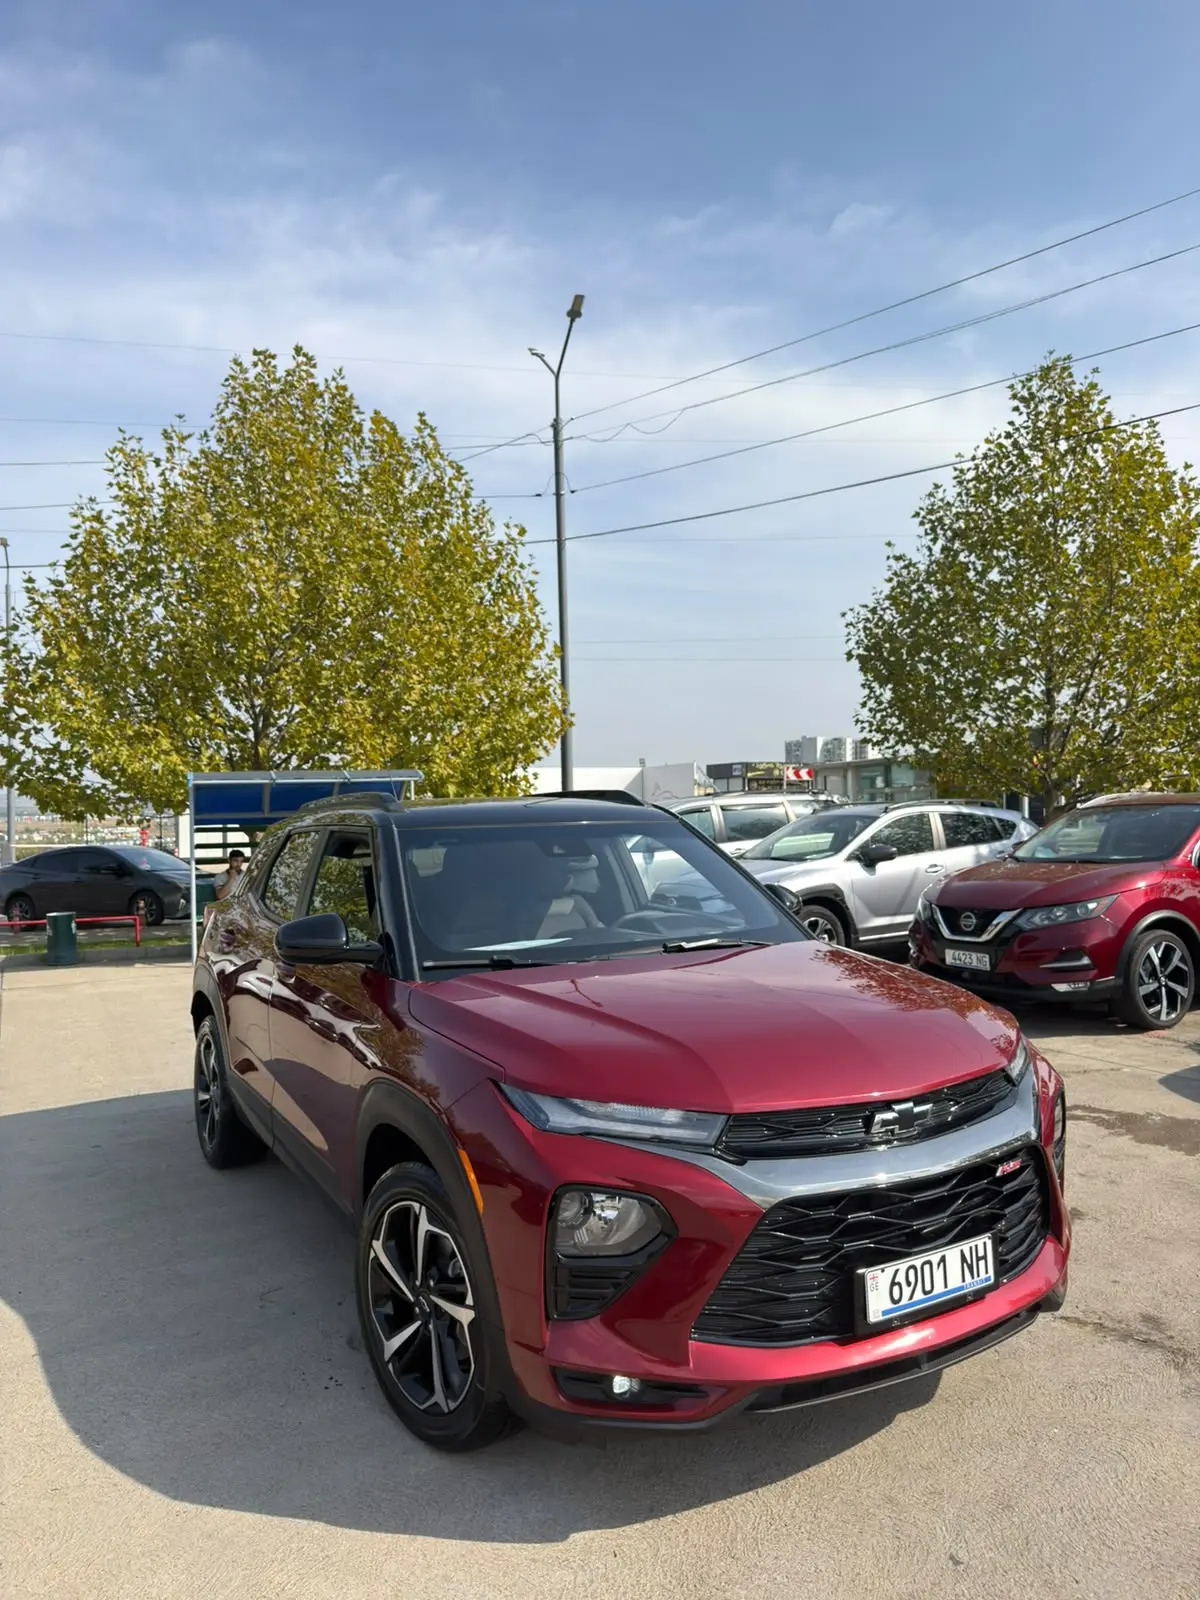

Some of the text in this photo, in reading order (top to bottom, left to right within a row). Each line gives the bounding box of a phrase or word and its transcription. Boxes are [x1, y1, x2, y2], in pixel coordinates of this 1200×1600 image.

[952, 951, 973, 965] 4423
[889, 1241, 989, 1306] 6901 NH
